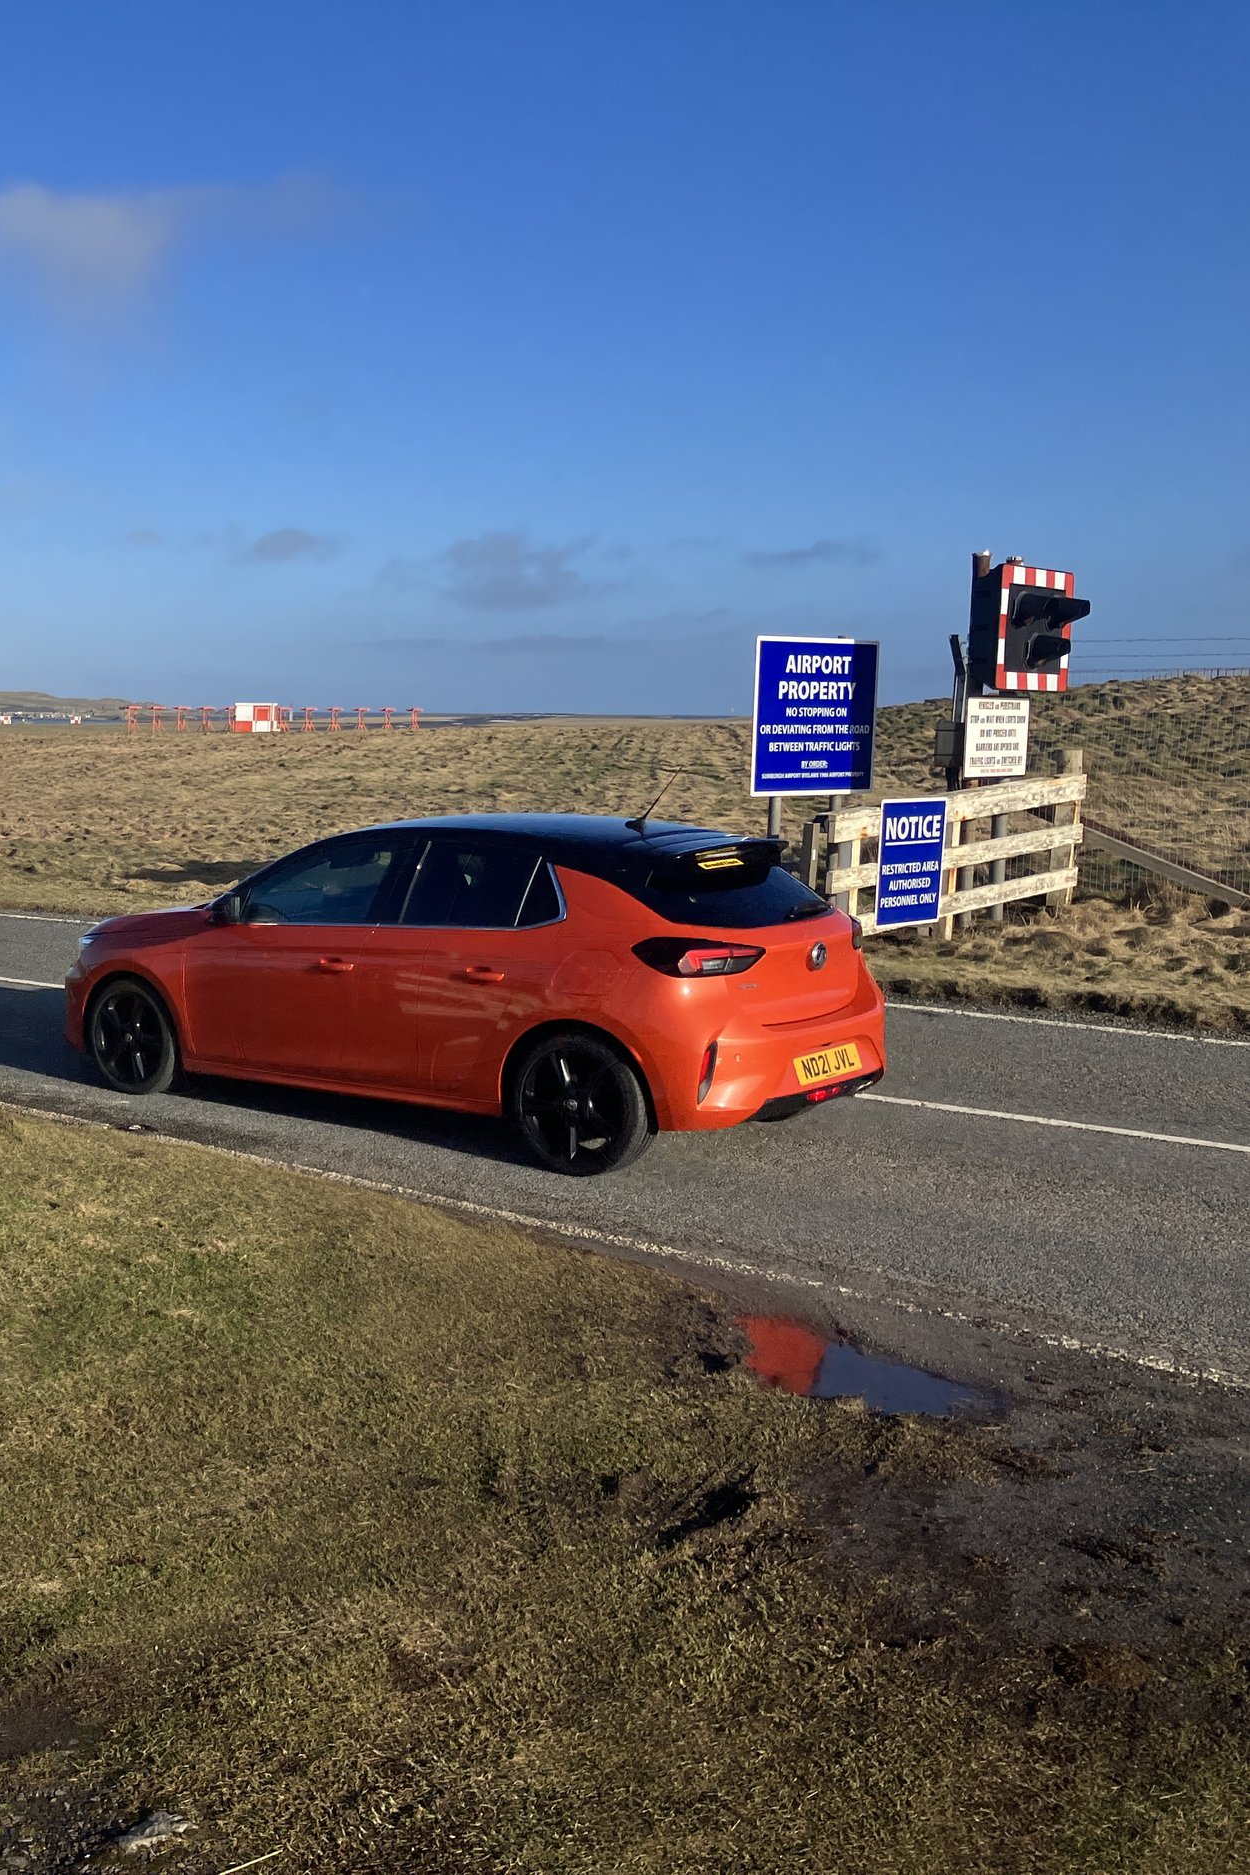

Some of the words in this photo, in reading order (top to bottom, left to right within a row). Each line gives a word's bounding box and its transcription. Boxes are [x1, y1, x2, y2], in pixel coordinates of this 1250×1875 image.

[786, 654, 852, 674] AIRPORT
[778, 680, 856, 700] PROPERTY
[786, 707, 798, 717] NO
[799, 708, 834, 717] STOPPING
[836, 708, 848, 717] ON
[760, 725, 770, 734] OR
[772, 724, 811, 734] DEVIATING
[813, 724, 834, 734] FROM
[835, 724, 848, 734] THE
[850, 725, 870, 734] ROAD
[769, 742, 804, 752] BETWEEN
[805, 742, 834, 751] TRAFFIC
[835, 742, 860, 751] LIGHTS
[886, 814, 942, 840] NOTICE
[882, 862, 920, 875] RESTRICTED
[922, 861, 938, 872] AREA
[889, 877, 930, 891] AUTHORISED
[880, 896, 918, 908] PERSONNEL
[920, 893, 936, 903] ONLY
[801, 1053, 831, 1079] ND21
[834, 1048, 854, 1070] JVL
